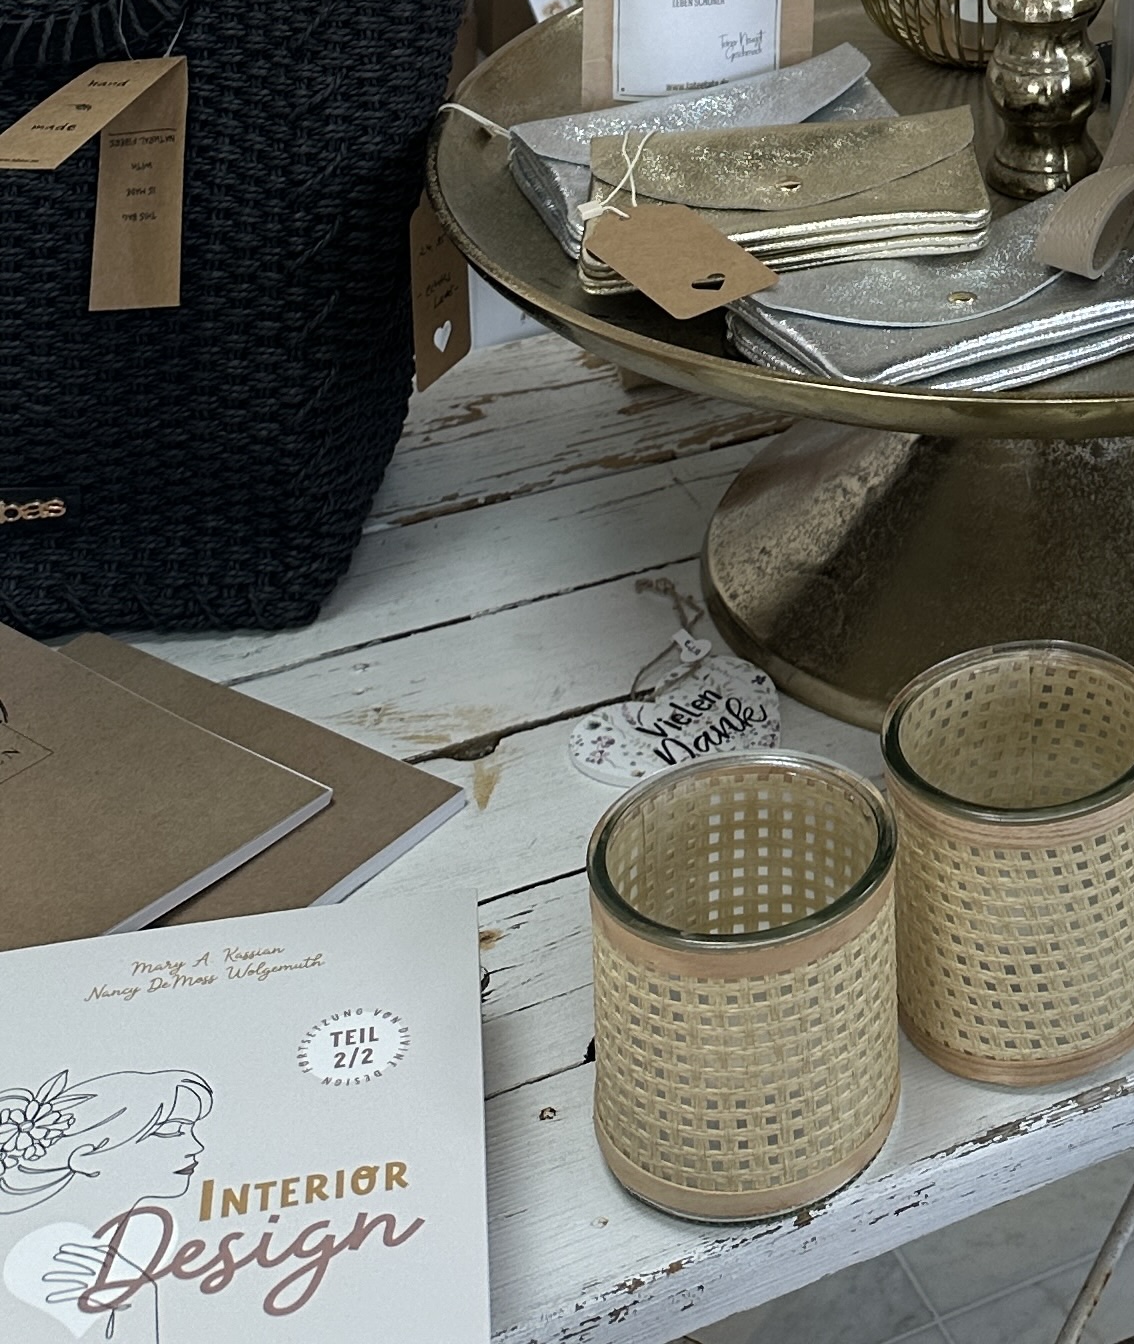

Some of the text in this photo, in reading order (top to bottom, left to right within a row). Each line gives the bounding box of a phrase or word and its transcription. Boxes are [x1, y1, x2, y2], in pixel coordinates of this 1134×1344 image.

[87, 79, 131, 88] hand
[31, 122, 77, 132] made
[139, 135, 176, 146] NATURAL
[131, 959, 187, 977] Mary
[223, 947, 285, 962] Kassian
[84, 953, 326, 1002] Nancy DeMoss Wolgemuth
[296, 1008, 411, 1087] FORTSETZUNG VON DIVINE DESIGN
[330, 1026, 379, 1047] TEIL
[333, 1047, 374, 1069] 2/2
[199, 1160, 410, 1223] INTERIOR
[77, 1205, 426, 1318] Design
